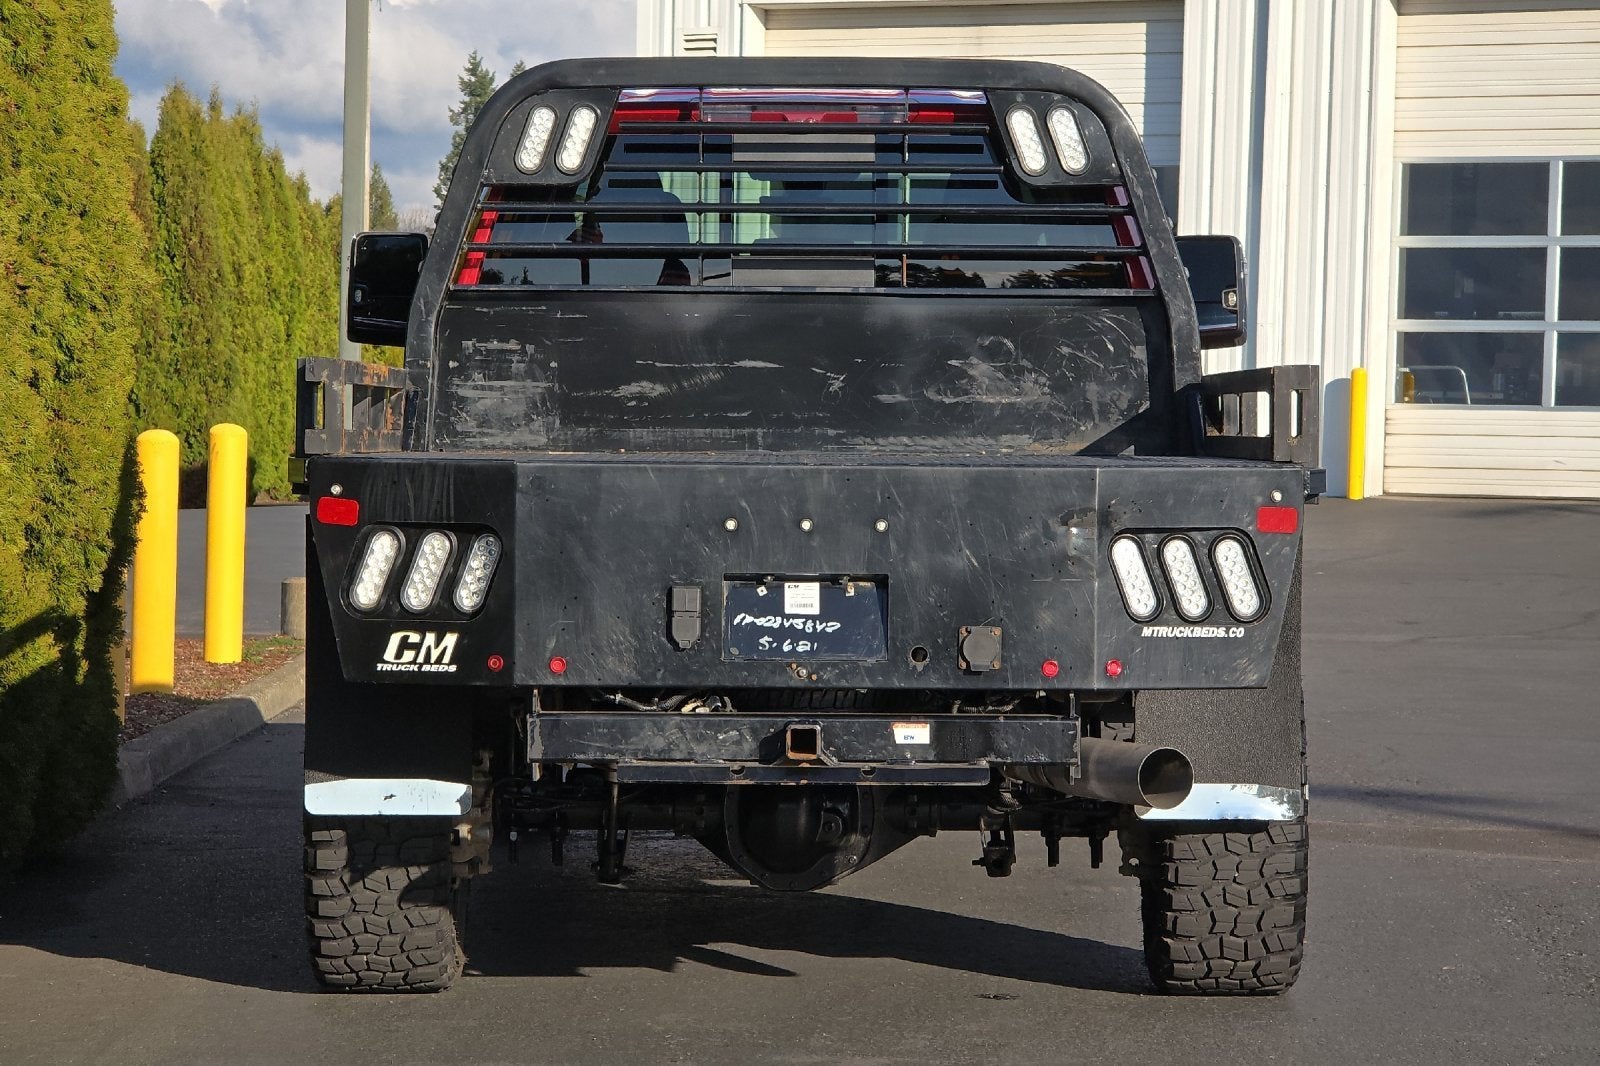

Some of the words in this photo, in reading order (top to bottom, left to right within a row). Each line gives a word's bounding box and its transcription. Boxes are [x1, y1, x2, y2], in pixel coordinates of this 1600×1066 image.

[383, 631, 459, 664] CM
[376, 663, 420, 672] TRUCK
[421, 664, 457, 673] BEDS
